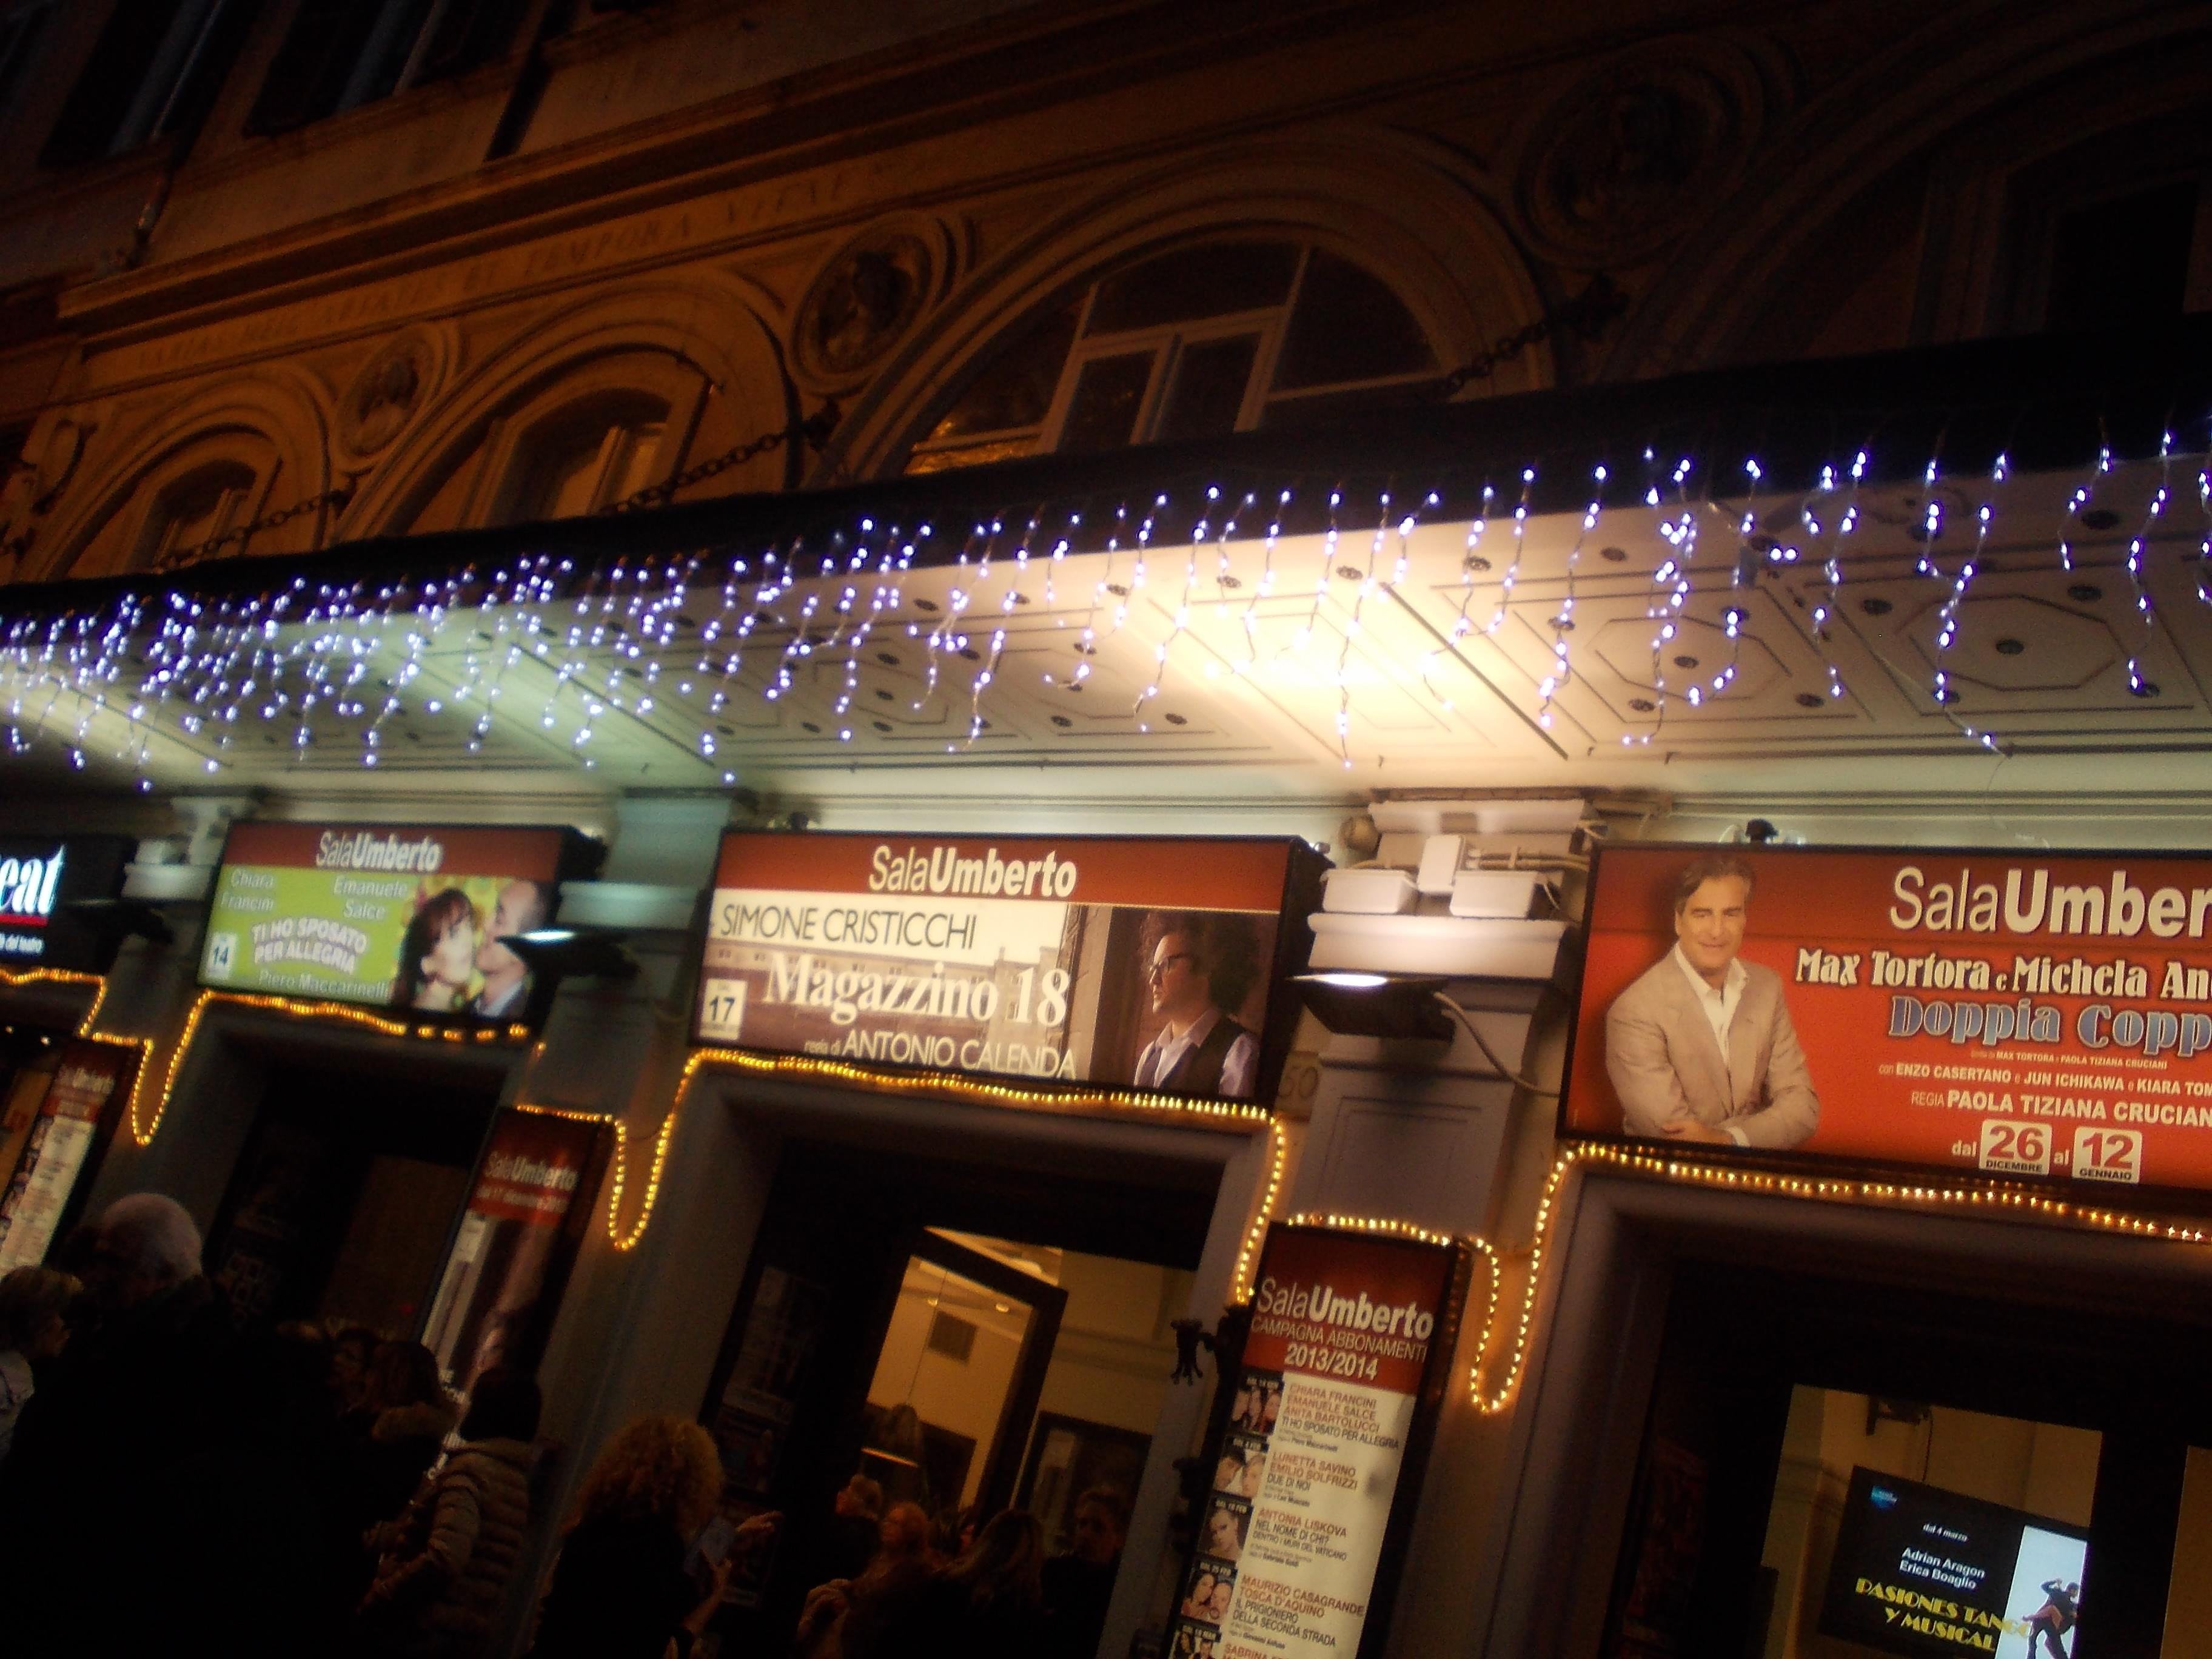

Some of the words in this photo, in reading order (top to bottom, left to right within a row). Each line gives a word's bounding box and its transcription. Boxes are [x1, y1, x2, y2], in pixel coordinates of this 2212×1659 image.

[316, 831, 444, 872] SalaUmberto
[869, 845, 1077, 897] SalaUmberto
[720, 904, 817, 940] SIMONE
[823, 908, 977, 950] CRISTICCHI
[213, 946, 229, 965] 14
[1795, 948, 1860, 987] Max
[1871, 950, 1991, 991] Tortora
[1996, 973, 2007, 991] e
[2012, 956, 2147, 998] Michela
[763, 952, 999, 1025] Magazzino
[1005, 967, 1071, 1028] 18
[709, 996, 735, 1022] 17
[1888, 995, 2061, 1045] Doppia
[841, 1028, 954, 1069] ANTONIO
[961, 1039, 1077, 1081] CALENDA
[1896, 1062, 1930, 1078] ENZO
[1934, 1065, 2011, 1084] CASERTANO
[2024, 1071, 2052, 1087] JUN
[2056, 1073, 2124, 1091] ICHIKAWA
[2136, 1078, 2181, 1094] KIARA
[1911, 1091, 1945, 1107] REGIA
[1947, 1090, 2014, 1113] PAOLA
[2020, 1094, 2107, 1120] TIZIANA
[1951, 1139, 1977, 1158] dal
[1987, 1125, 2044, 1162] 26
[2054, 1148, 2070, 1166] al
[2082, 1132, 2134, 1169] 12
[1986, 1159, 2043, 1173] DICEMBRE
[2079, 1167, 2132, 1181] GENNAIO
[1256, 1276, 1435, 1341] SalaUmberto
[1251, 1316, 1324, 1345] CAMPAGNA
[1326, 1330, 1428, 1364] ABBONAMENTI
[1284, 1343, 1379, 1381] 2013/2014
[1287, 1395, 1340, 1413] EMANUELE
[1343, 1406, 1376, 1422] SALCE
[1290, 1382, 1327, 1399] CHIARA
[1328, 1390, 1377, 1410] FRANCINI
[1304, 1421, 1341, 1438] SPOSATO
[1342, 1429, 1358, 1441] PER
[1359, 1433, 1399, 1449] ALLEGRIA
[1315, 1412, 1381, 1433] BARTOLUCCI
[1269, 1461, 1304, 1478] EMILIO
[1273, 1451, 1316, 1469] LUNETTA
[1318, 1460, 1357, 1478] SAVINO
[1267, 1473, 1283, 1485] DUE
[1285, 1476, 1295, 1487] DI
[1296, 1480, 1311, 1492] NOI
[1256, 1519, 1270, 1531] NEL
[1272, 1523, 1298, 1540] NOME
[1299, 1529, 1309, 1541] DI
[1309, 1532, 1330, 1547] CHI?
[1258, 1506, 1302, 1527] ANTONIA
[1304, 1518, 1347, 1538] LISKOVA
[1942, 1529, 1969, 1543] marzo
[1252, 1530, 1279, 1544] DENTRO
[1315, 1546, 1347, 1563] VATICANO
[1899, 1559, 1929, 1578] Erica
[1931, 1568, 1977, 1590] Boaglio
[1901, 1547, 1941, 1567] Adrian
[1942, 1557, 1986, 1579] Aragon
[1235, 1598, 1243, 1609] IL
[1244, 1600, 1299, 1624] PRIGIONIERO
[1239, 1586, 1272, 1603] TOSCA
[1275, 1595, 1326, 1619] D'AQUINO
[1241, 1574, 1292, 1597] MAURIZIO
[1293, 1587, 1365, 1617] CASAGRANDE
[1855, 1578, 1959, 1620] PASIONES
[1232, 1609, 1259, 1625] DELLA
[1259, 1617, 1301, 1637] SECONDA
[1302, 1627, 1337, 1647] STRADA
[1884, 1606, 1900, 1624] Y
[1900, 1612, 1996, 1653] MUSICAL
